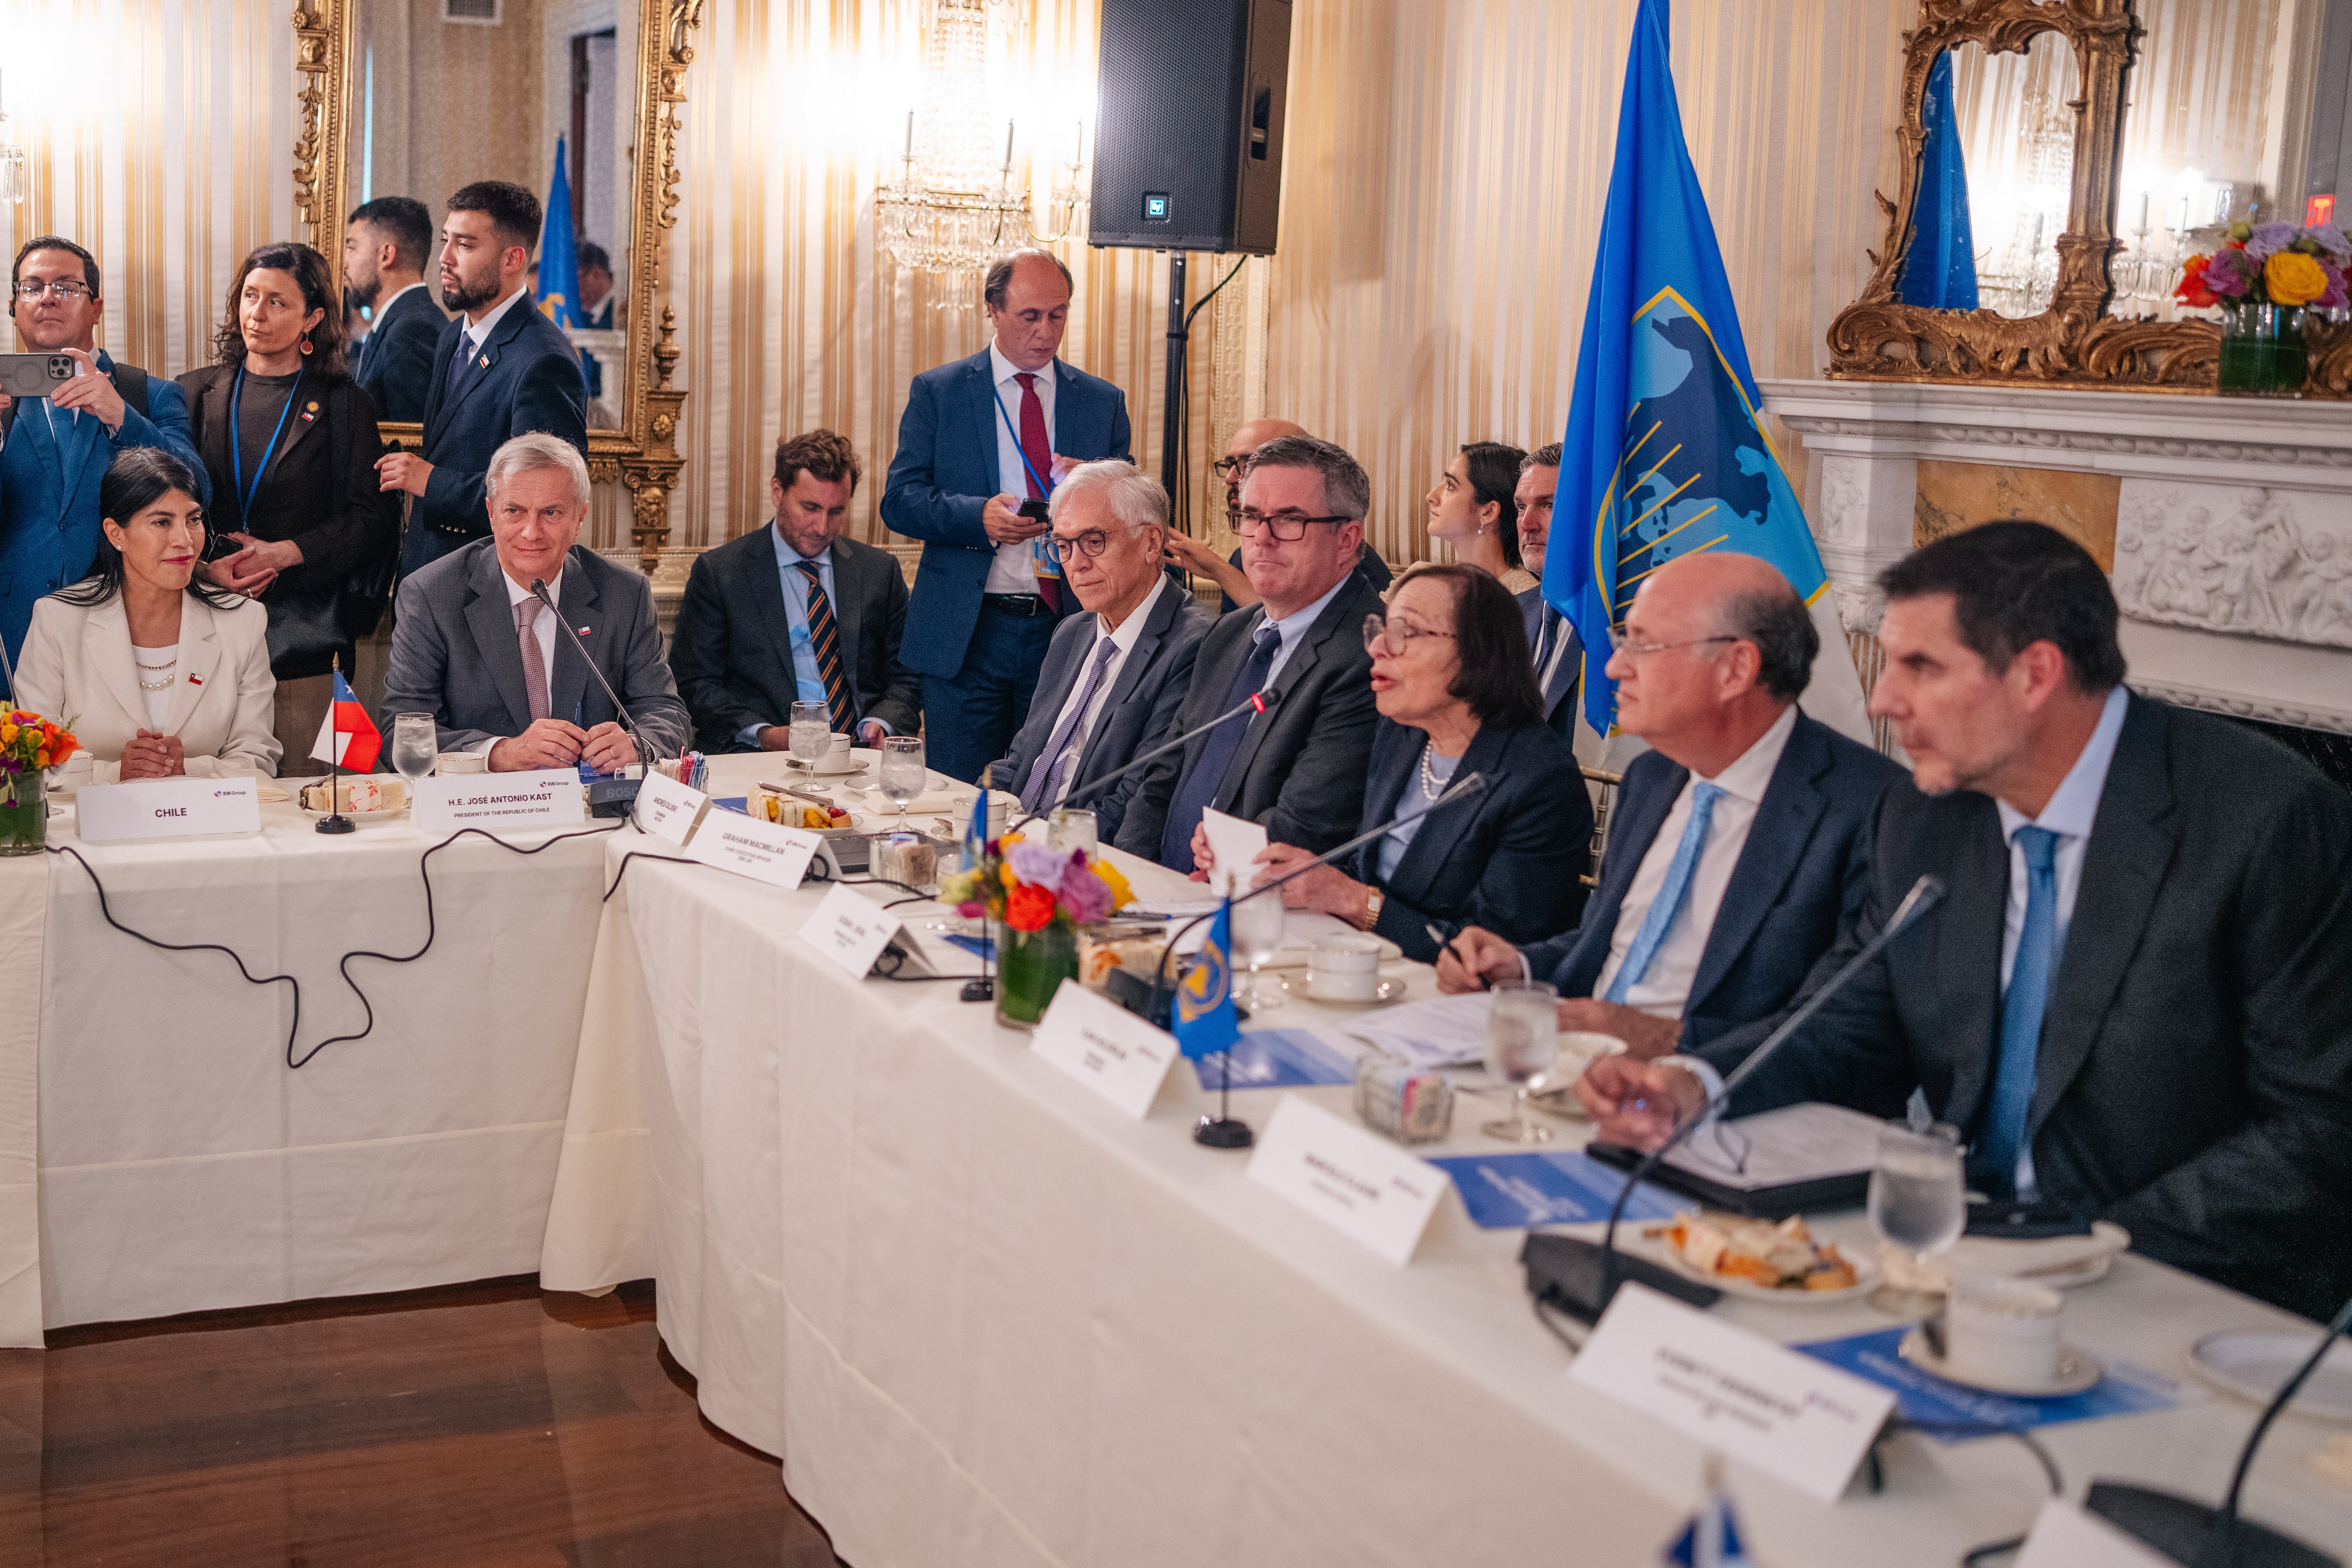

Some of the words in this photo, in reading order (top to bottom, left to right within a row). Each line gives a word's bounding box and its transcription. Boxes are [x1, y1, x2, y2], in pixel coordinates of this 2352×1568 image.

[606, 787, 639, 798] BOSC
[468, 795, 488, 805] JOSÉ
[490, 795, 528, 804] ANTONIO
[530, 793, 552, 801] KAST
[155, 807, 187, 818] CHILE
[723, 833, 749, 845] GRAHAM
[749, 840, 785, 854] MACMILLAN
